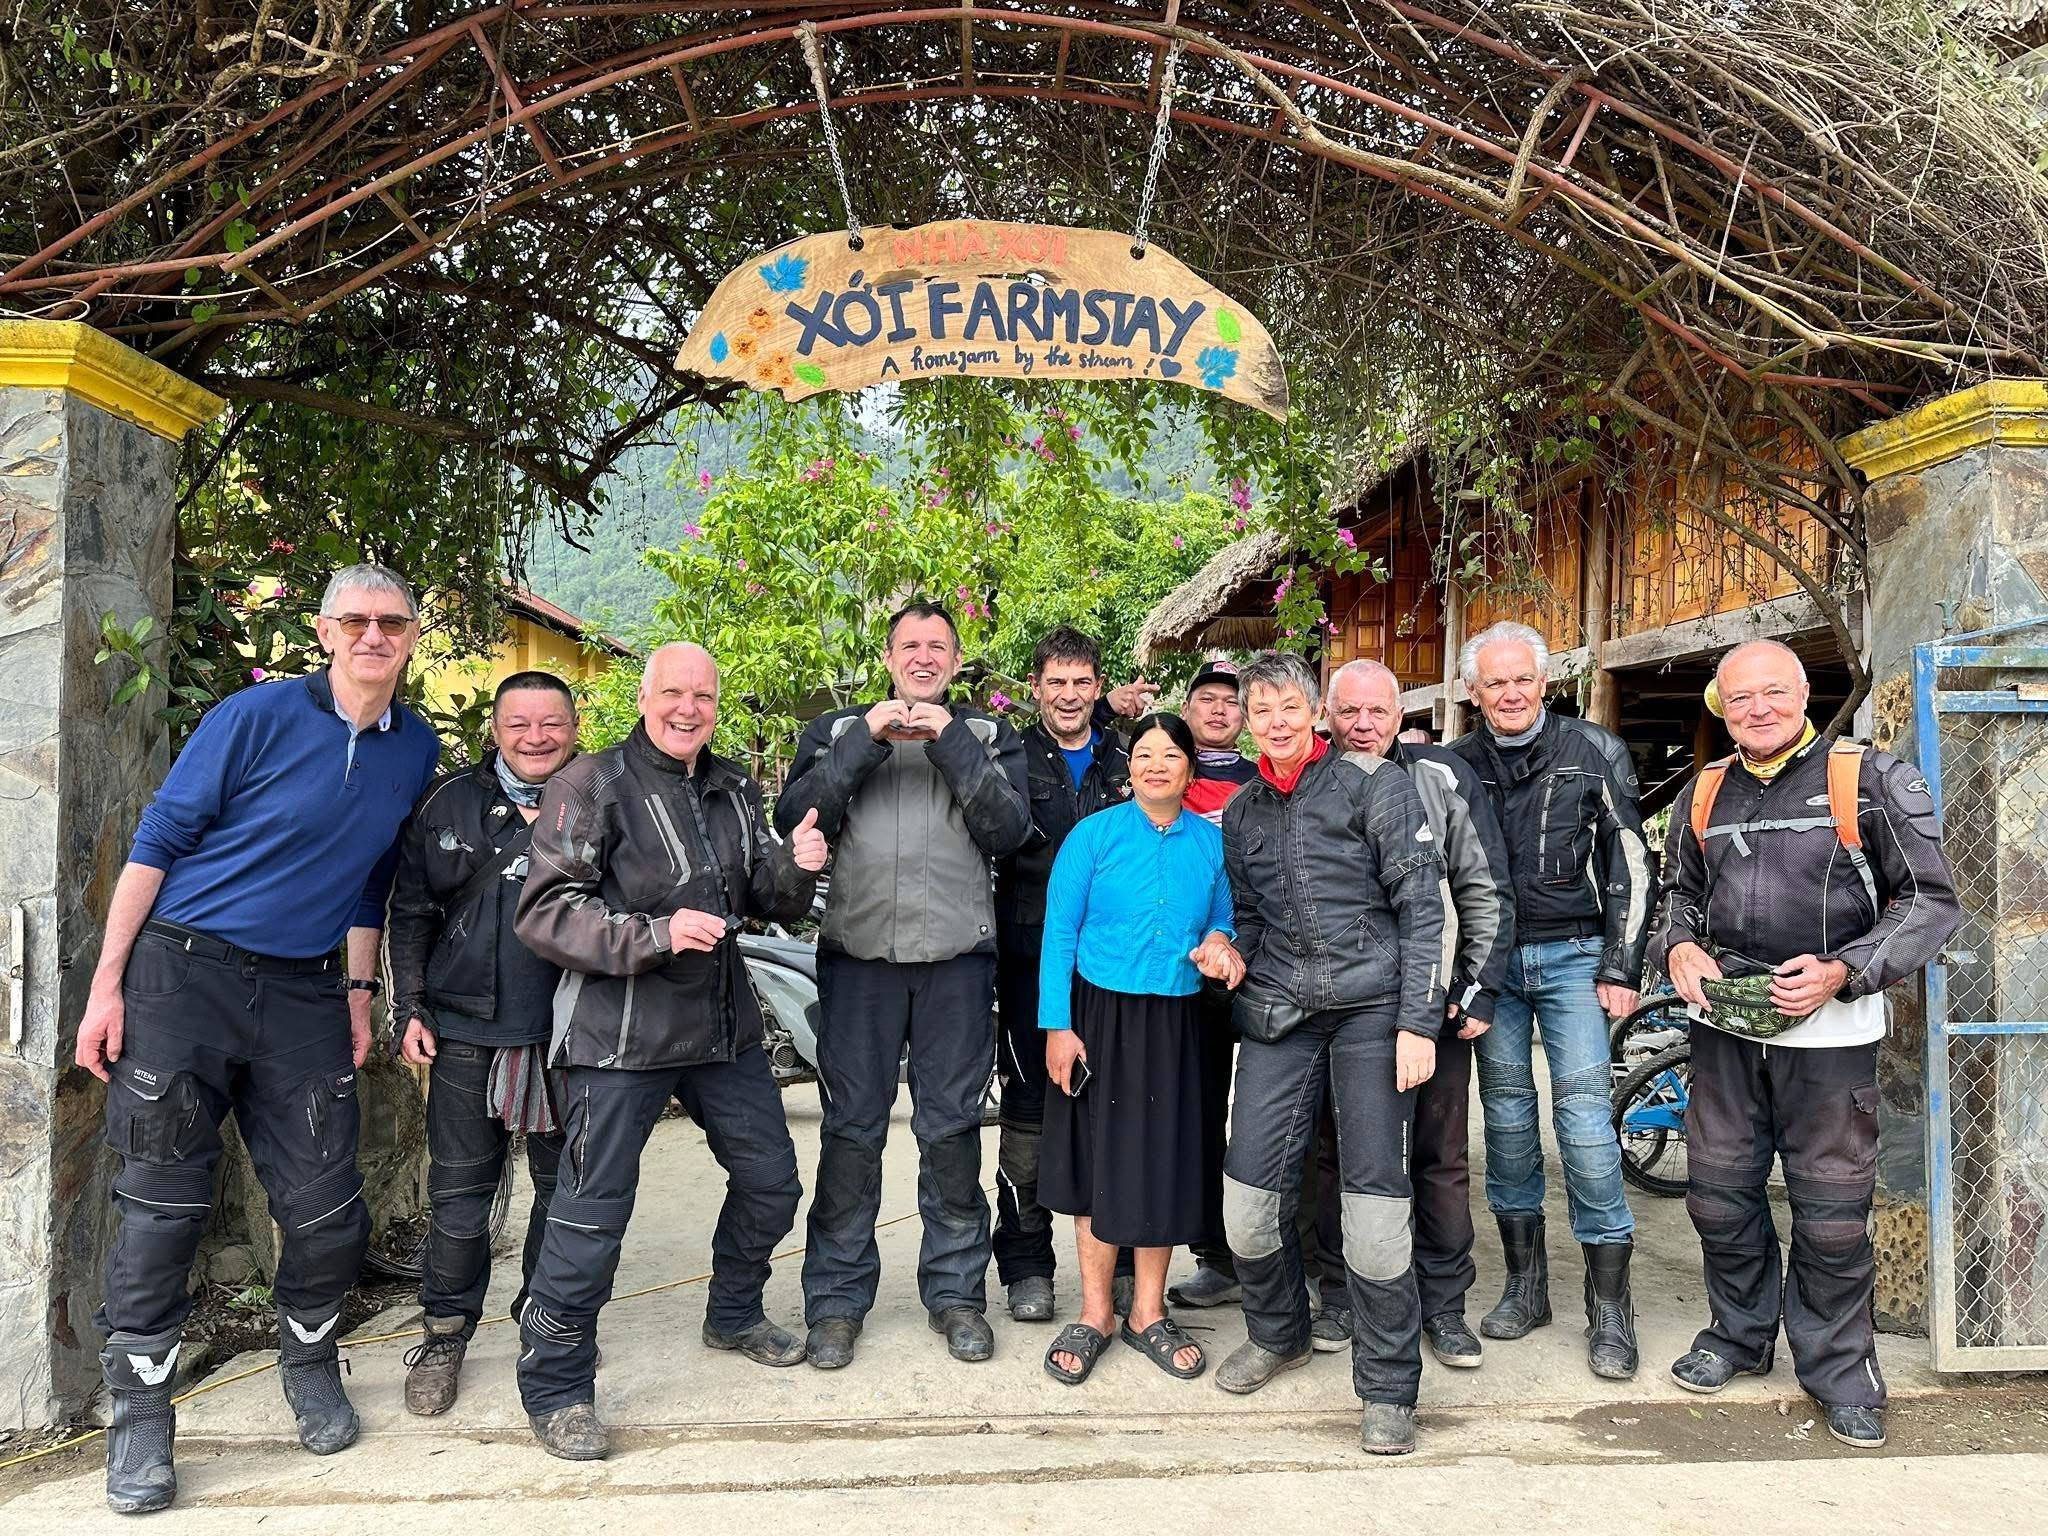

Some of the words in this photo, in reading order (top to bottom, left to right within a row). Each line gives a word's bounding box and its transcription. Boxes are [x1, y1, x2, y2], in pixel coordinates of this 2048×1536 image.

[785, 269, 917, 356] XỚI
[927, 281, 1206, 356] FARMSTAY
[881, 356, 900, 377] A
[1015, 344, 1034, 375] by
[1043, 344, 1073, 367] the
